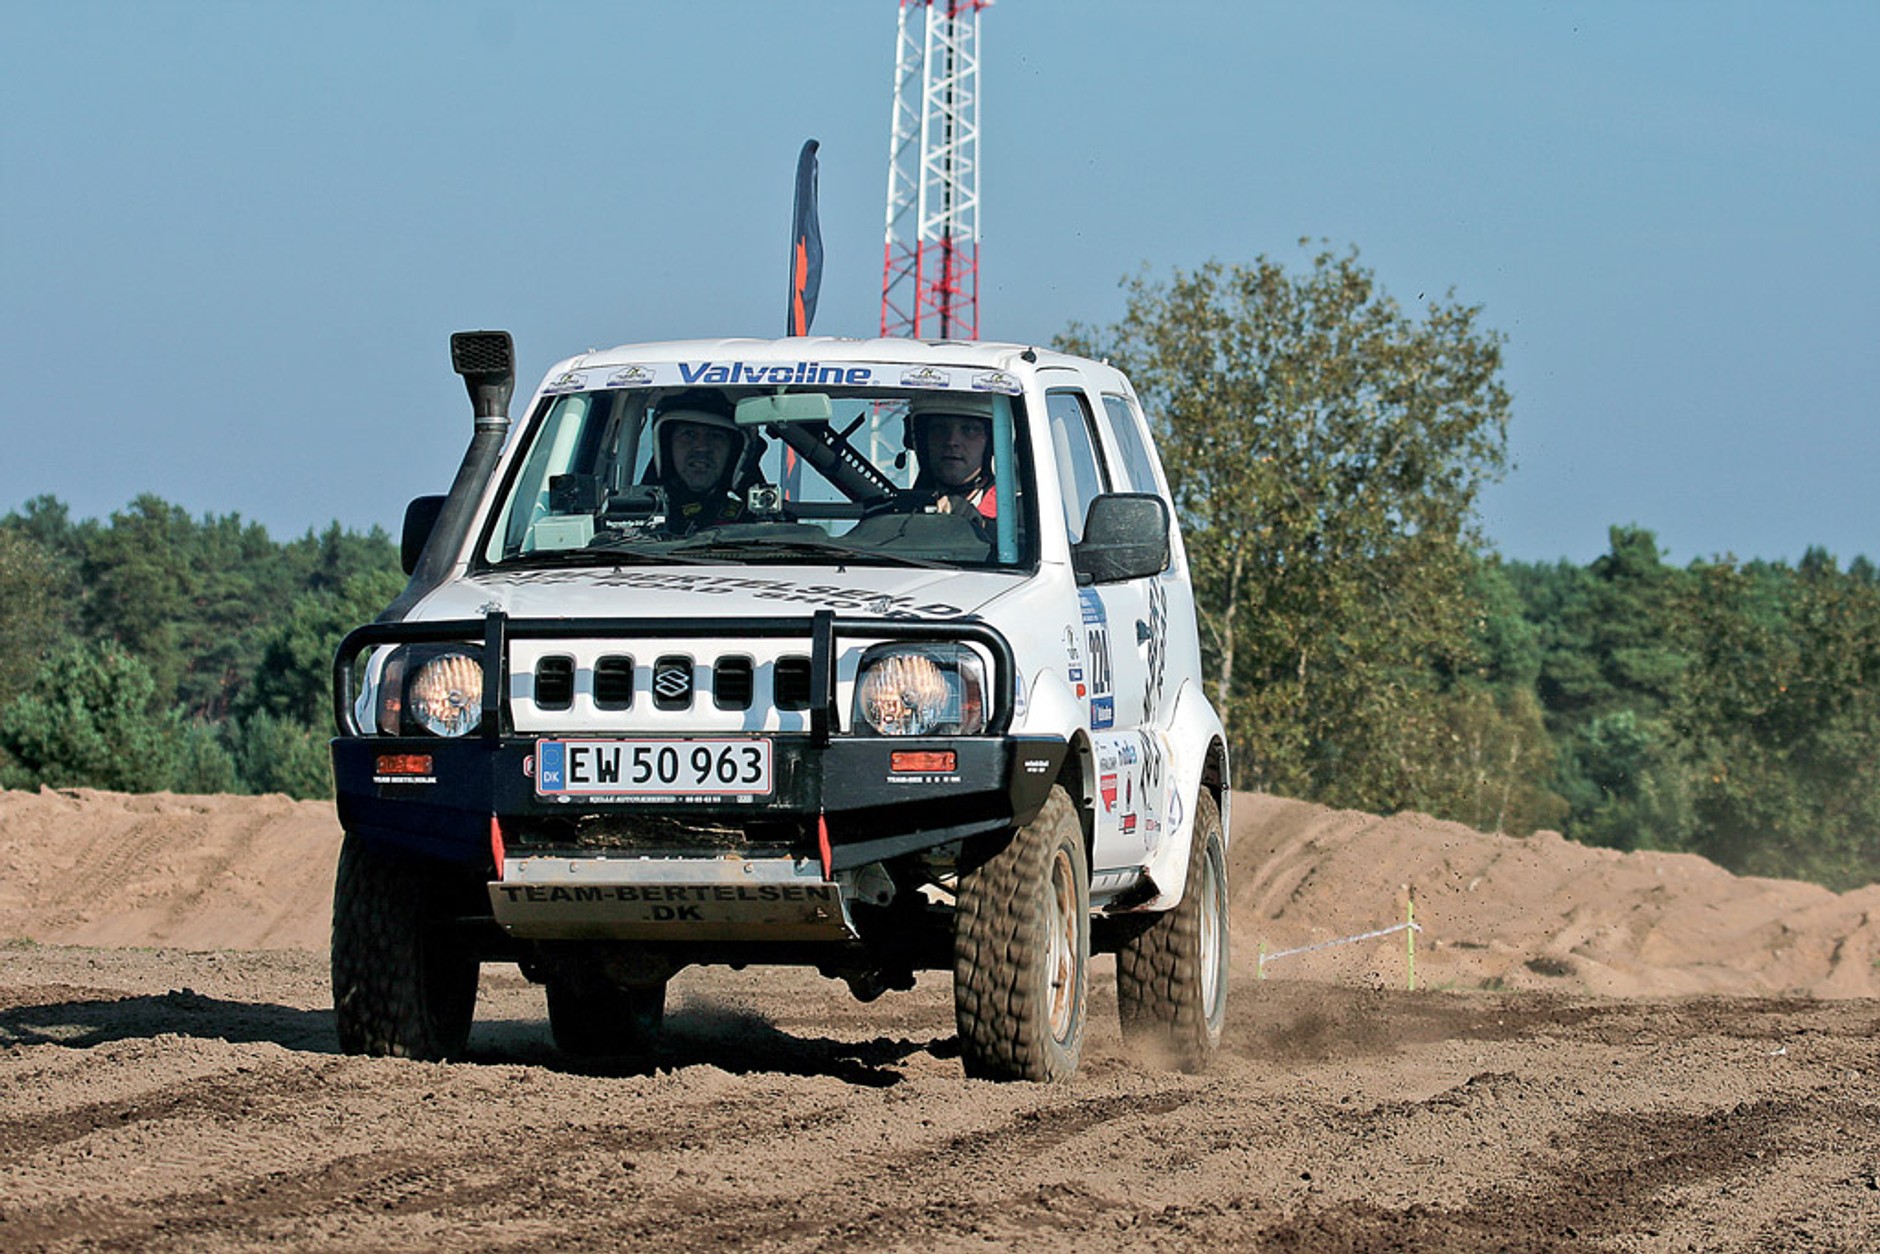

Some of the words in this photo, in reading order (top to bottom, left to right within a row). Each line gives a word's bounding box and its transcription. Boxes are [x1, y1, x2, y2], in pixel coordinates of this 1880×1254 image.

[677, 361, 872, 385] Valvoline
[569, 746, 620, 783] EW
[631, 746, 679, 783] 50
[690, 745, 763, 784] 963
[543, 769, 560, 783] DK
[499, 884, 832, 902] TEAM-BERTELSEN
